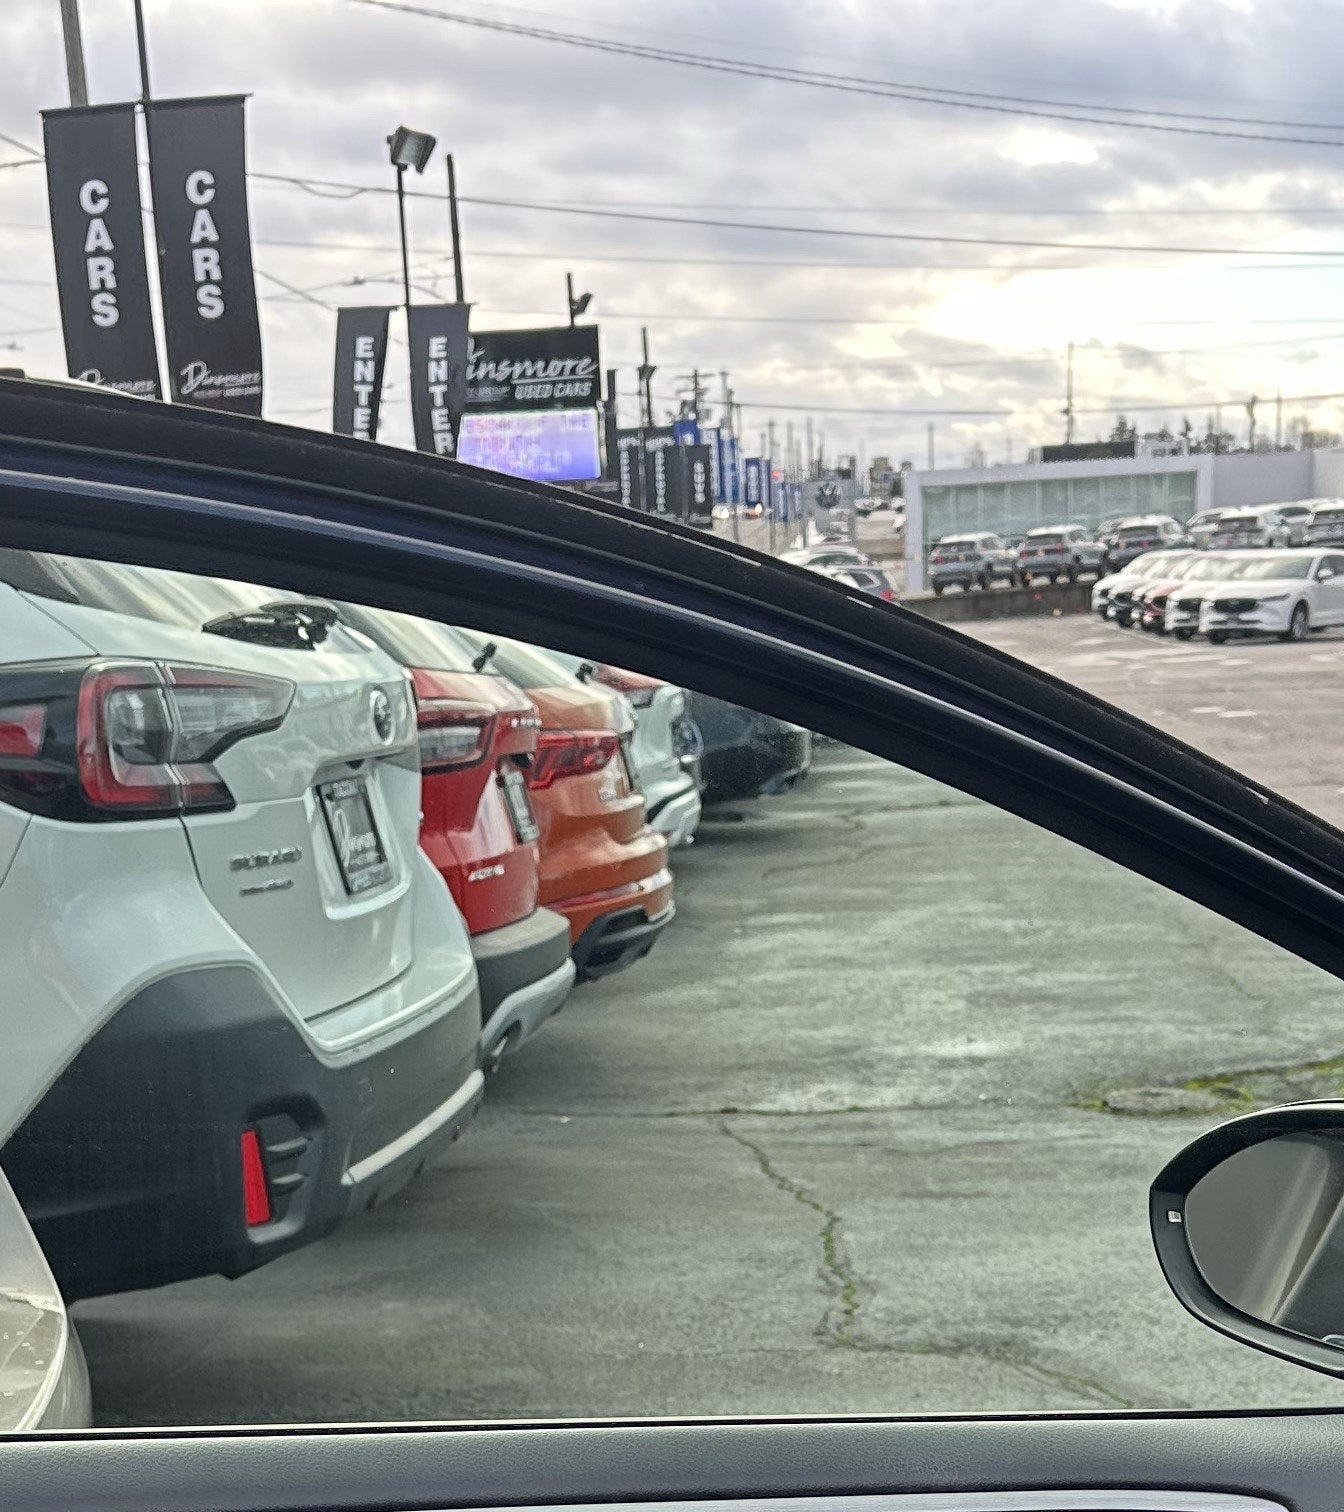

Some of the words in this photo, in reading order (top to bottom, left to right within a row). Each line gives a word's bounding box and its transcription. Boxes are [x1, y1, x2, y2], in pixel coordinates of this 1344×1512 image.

[79, 179, 120, 328] CARS
[185, 170, 225, 319] CARS
[428, 336, 454, 454] ENTER
[466, 337, 598, 382] insmore
[514, 384, 553, 400] USED
[553, 382, 592, 398] CARS
